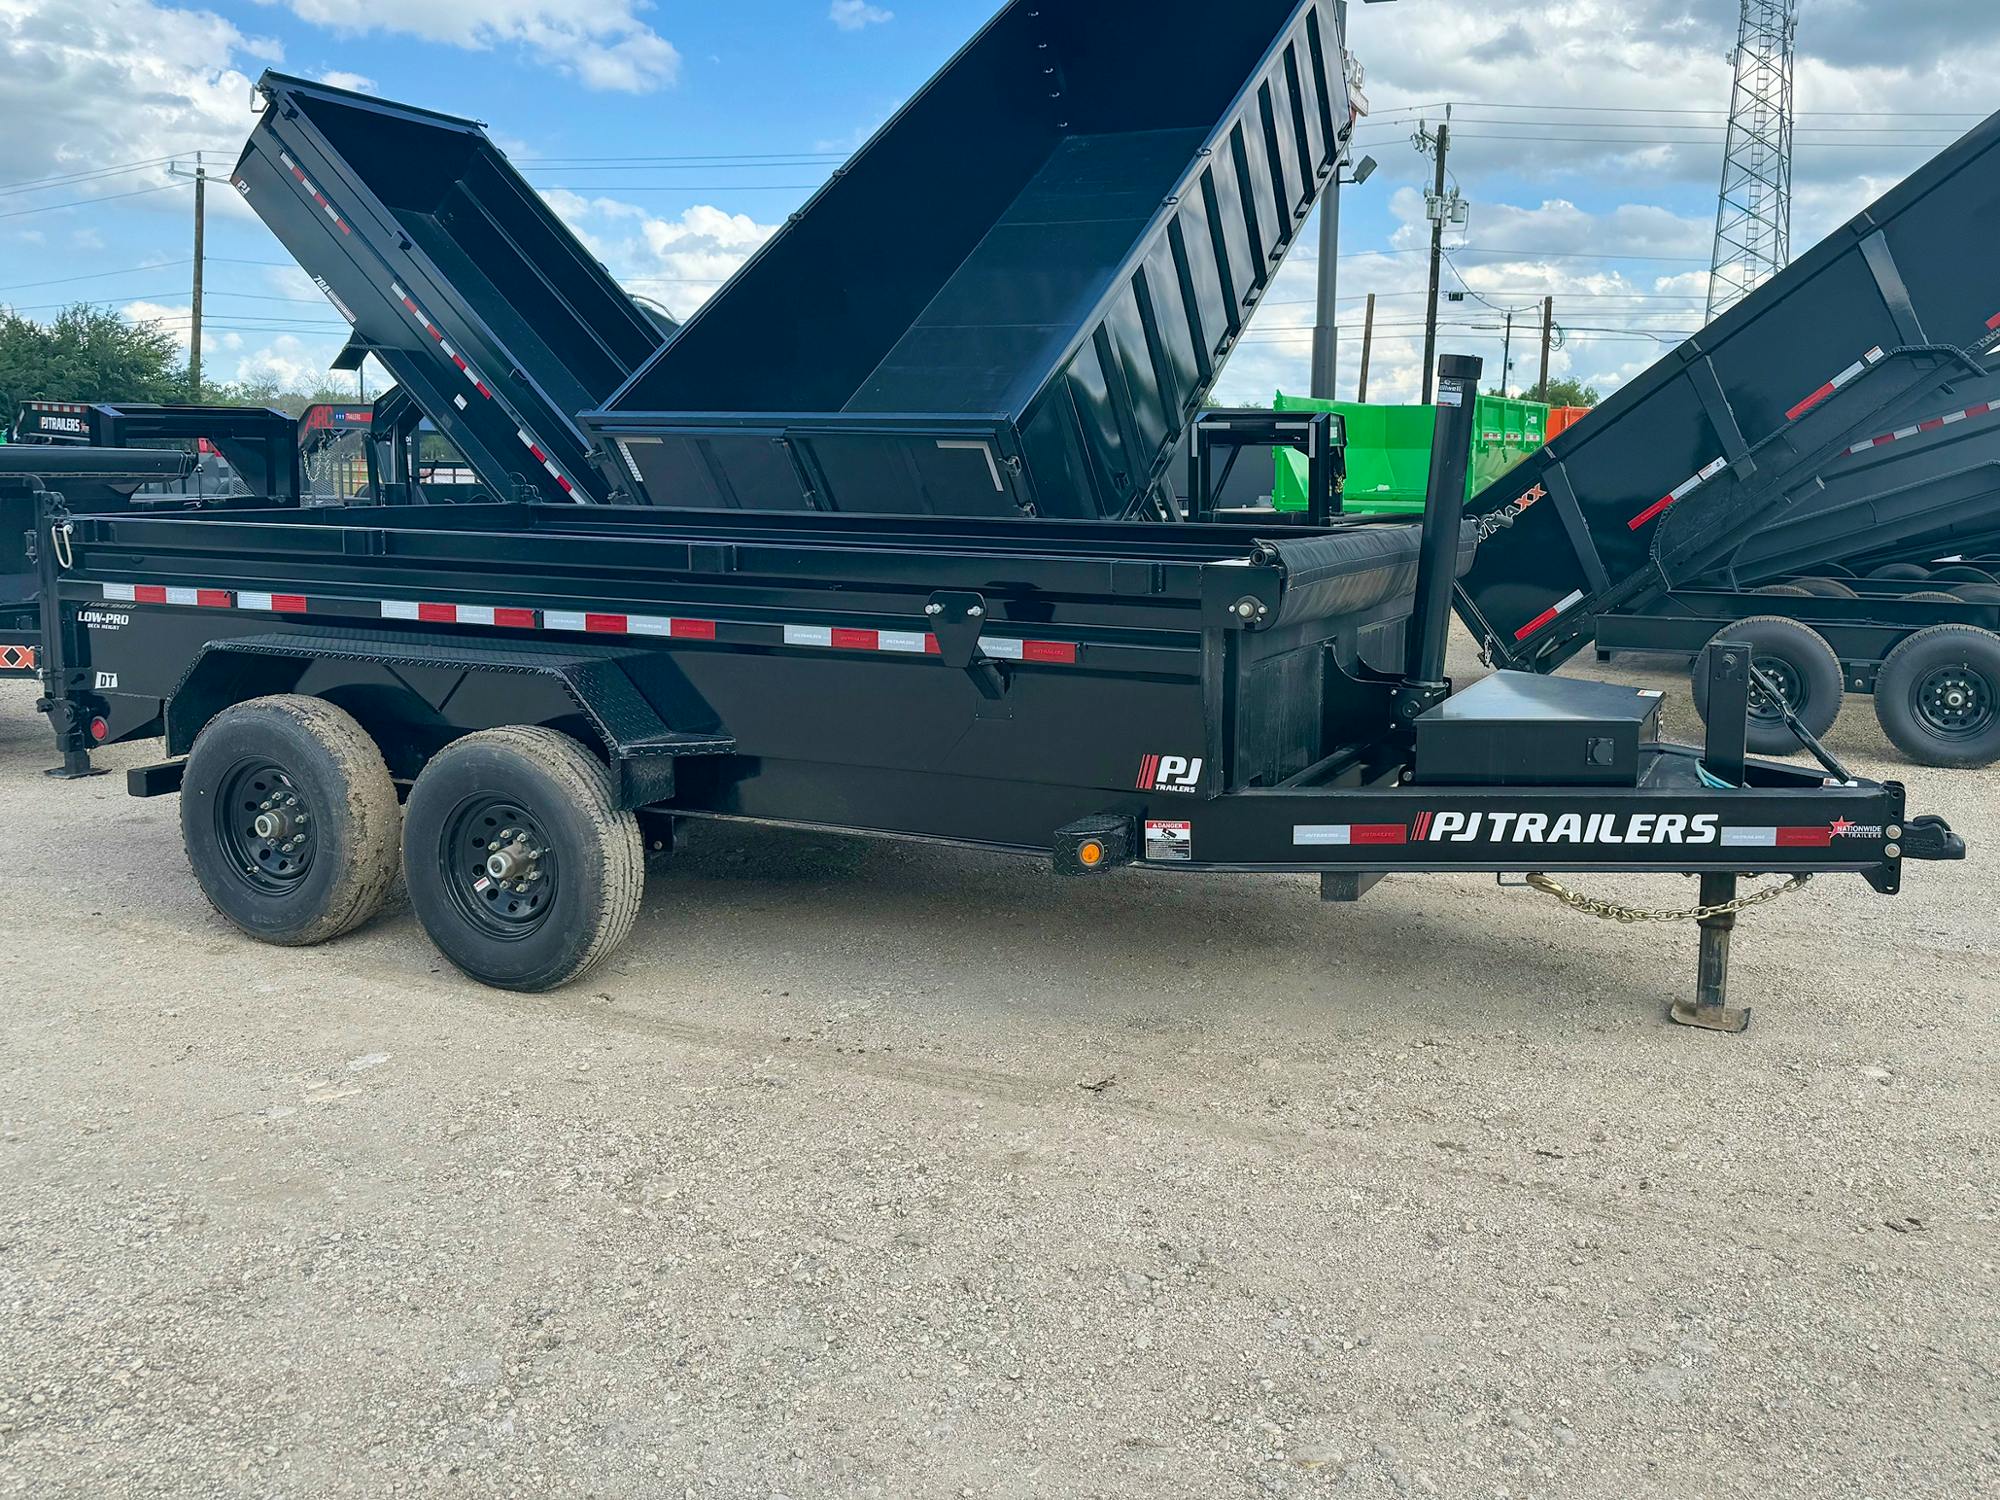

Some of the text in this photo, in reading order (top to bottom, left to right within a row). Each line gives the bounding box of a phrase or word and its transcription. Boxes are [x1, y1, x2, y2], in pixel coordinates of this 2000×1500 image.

[48, 417, 80, 432] TRAILERS
[301, 405, 334, 443] ARC
[77, 610, 130, 625] LOW-PRO
[100, 674, 115, 687] DT
[1156, 755, 1203, 785] PJ
[1155, 784, 1196, 793] TRAILERS
[1428, 811, 1719, 844] PJ TRAILERS
